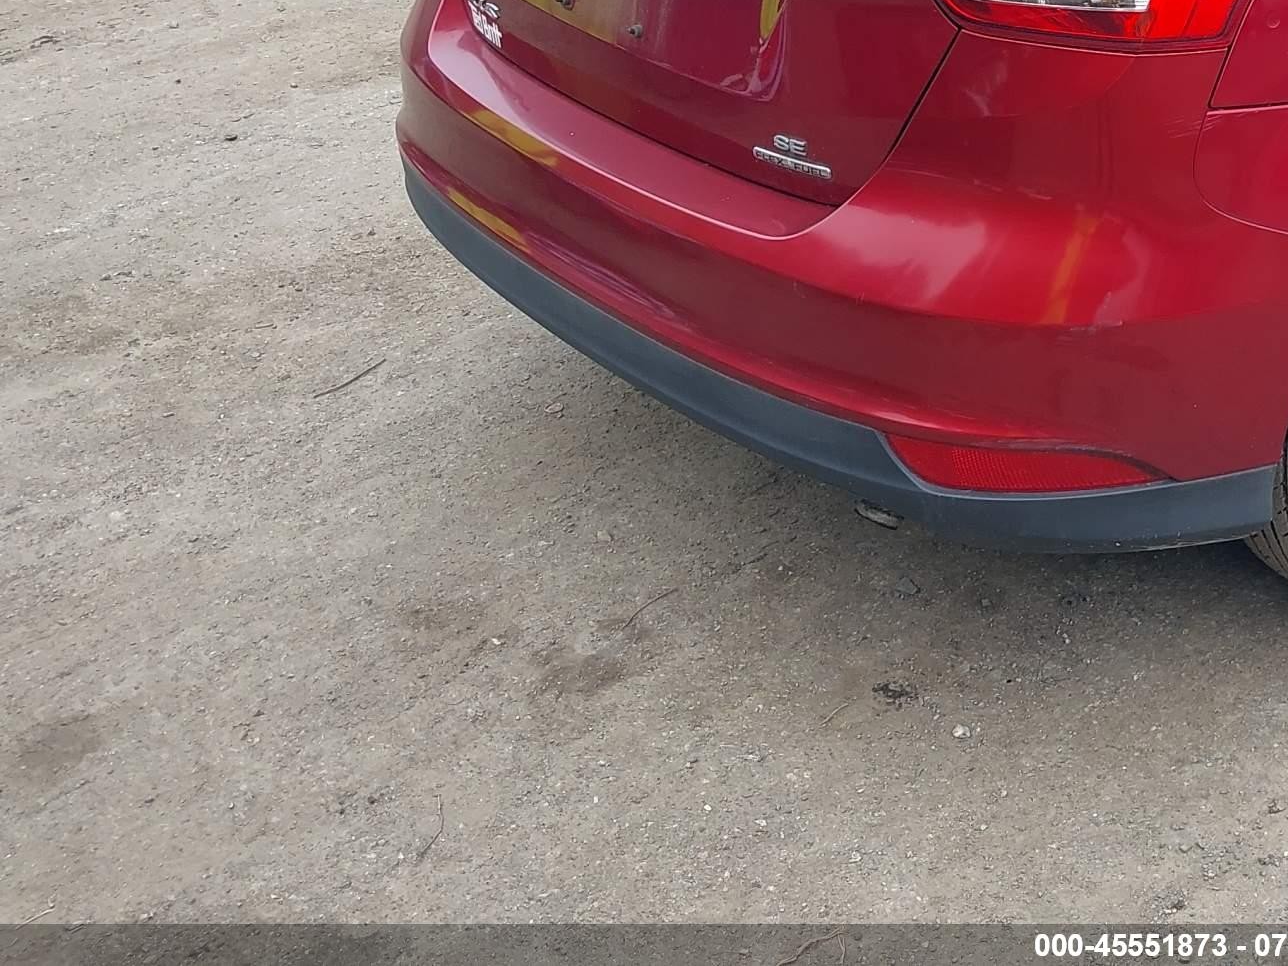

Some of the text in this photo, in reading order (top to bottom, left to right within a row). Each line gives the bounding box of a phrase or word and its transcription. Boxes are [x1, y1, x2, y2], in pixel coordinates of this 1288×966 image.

[773, 134, 807, 156] SE
[755, 149, 828, 178] FLEX FUEL
